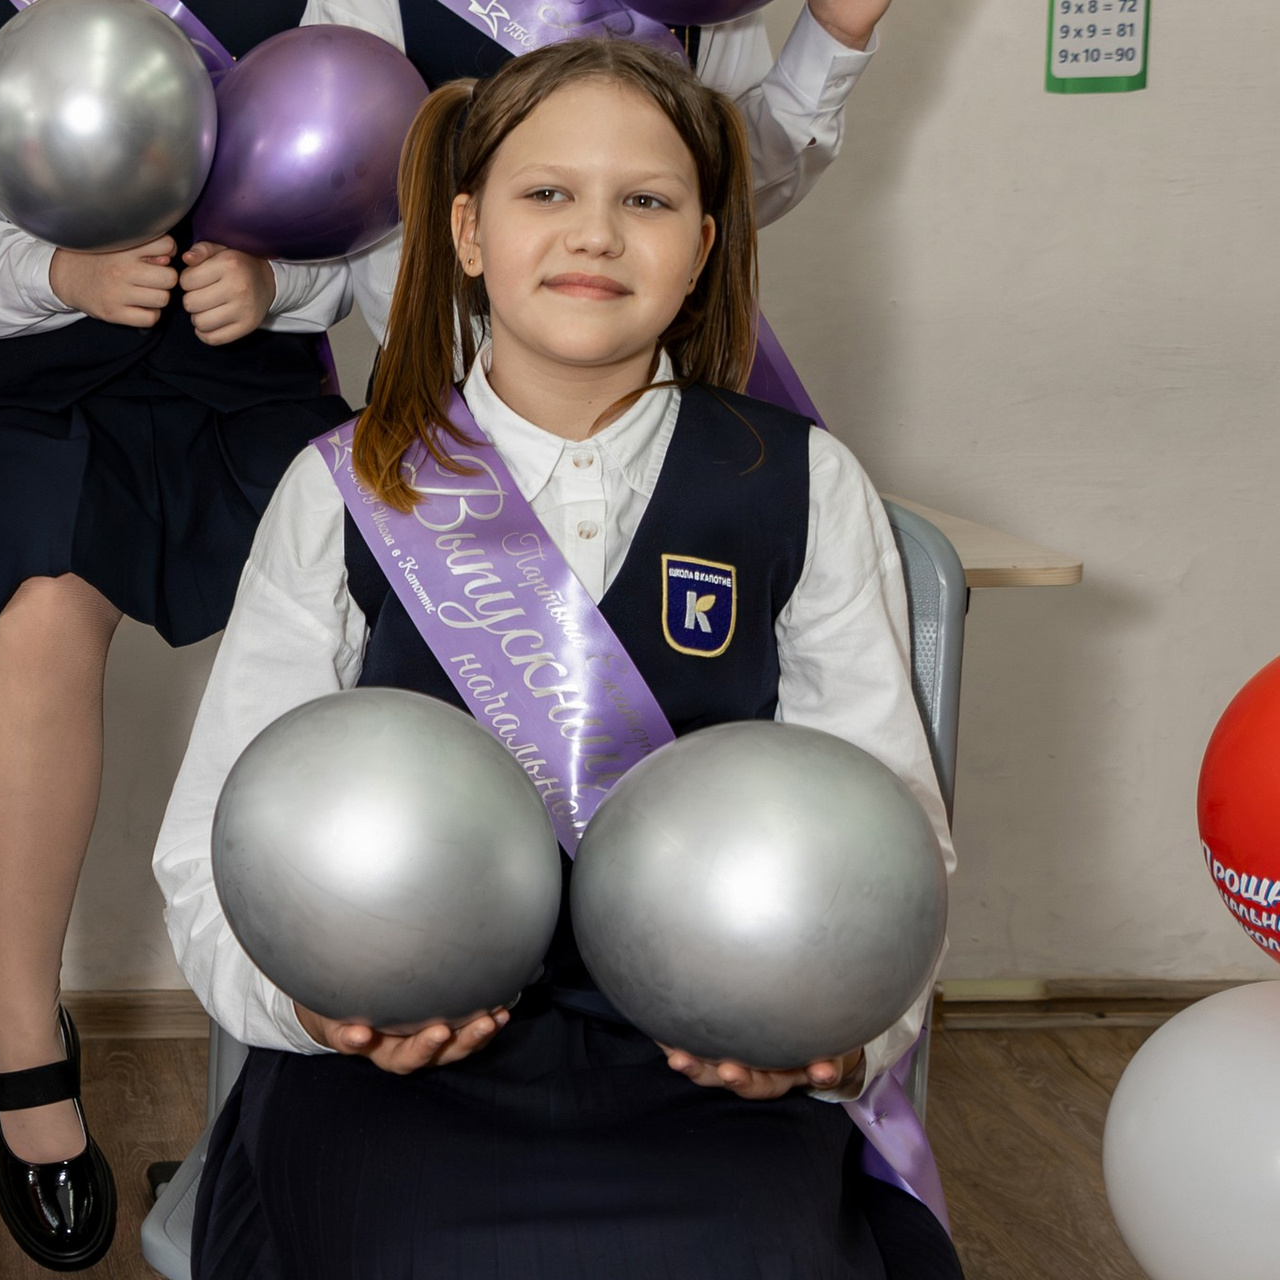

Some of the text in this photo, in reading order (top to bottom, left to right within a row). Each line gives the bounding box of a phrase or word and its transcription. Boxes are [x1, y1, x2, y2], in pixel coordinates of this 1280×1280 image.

[503, 20, 538, 52] ГБО
[370, 505, 396, 547] Школа
[391, 548, 402, 558] в
[398, 555, 437, 615] Капотне
[669, 567, 732, 587] ШКОЛА В КАПОТНЕ
